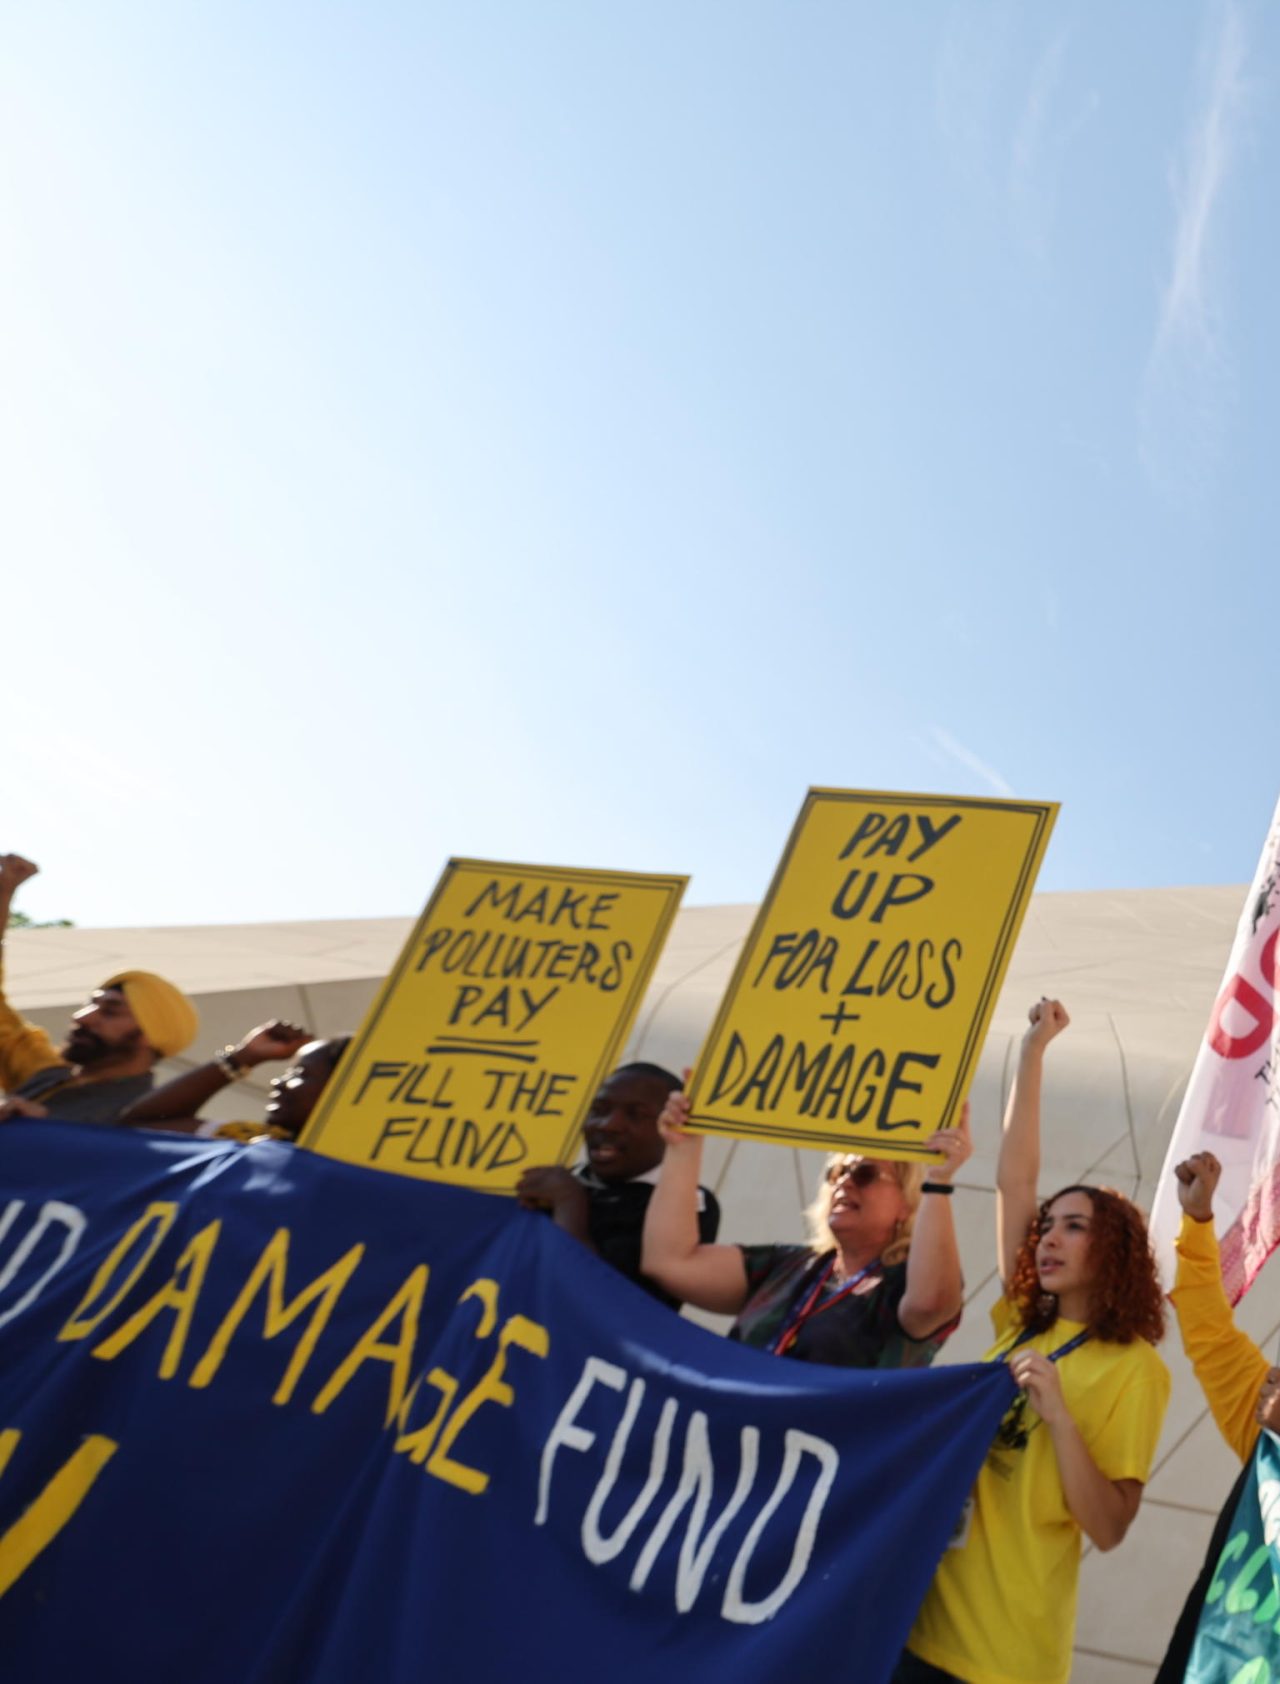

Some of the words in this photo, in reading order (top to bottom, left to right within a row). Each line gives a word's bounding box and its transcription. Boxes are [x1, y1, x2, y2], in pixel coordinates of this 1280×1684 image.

[839, 812, 962, 863] PAY
[463, 879, 620, 930] MAKE
[831, 869, 935, 924] UP
[415, 927, 633, 992] POLLUTERS
[753, 930, 839, 993] FOR
[844, 938, 962, 1010] LOSS
[448, 985, 560, 1027] PAY
[352, 1060, 455, 1110] FILL
[484, 1069, 578, 1117] THE
[705, 1030, 942, 1132] DAMAGE
[369, 1116, 530, 1171] FUND
[56, 1201, 549, 1494] DAMAGE
[534, 1356, 839, 1625] FUND
